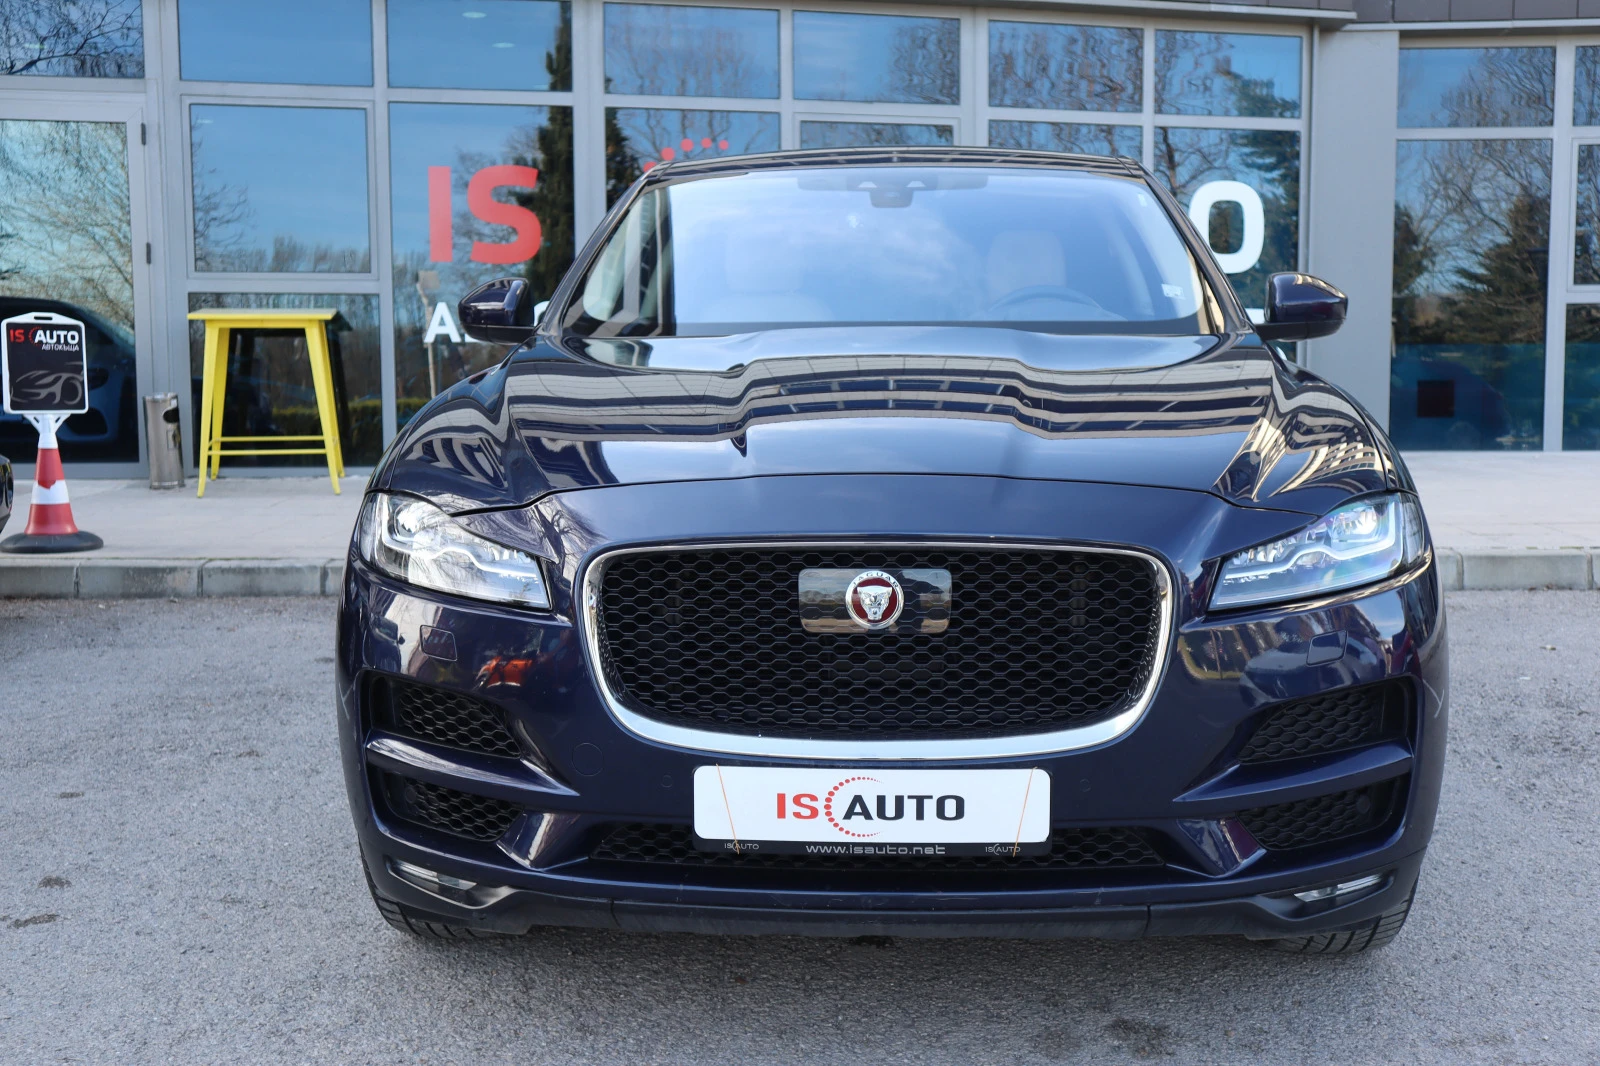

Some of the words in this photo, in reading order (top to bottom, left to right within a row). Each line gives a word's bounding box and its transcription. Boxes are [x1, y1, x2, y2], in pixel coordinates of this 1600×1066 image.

[428, 164, 542, 265] IS
[9, 329, 25, 342] IS
[35, 330, 79, 344] AUTO
[776, 793, 819, 820] IS
[842, 795, 965, 821] AUTO
[805, 844, 946, 855] www.isauto.net
